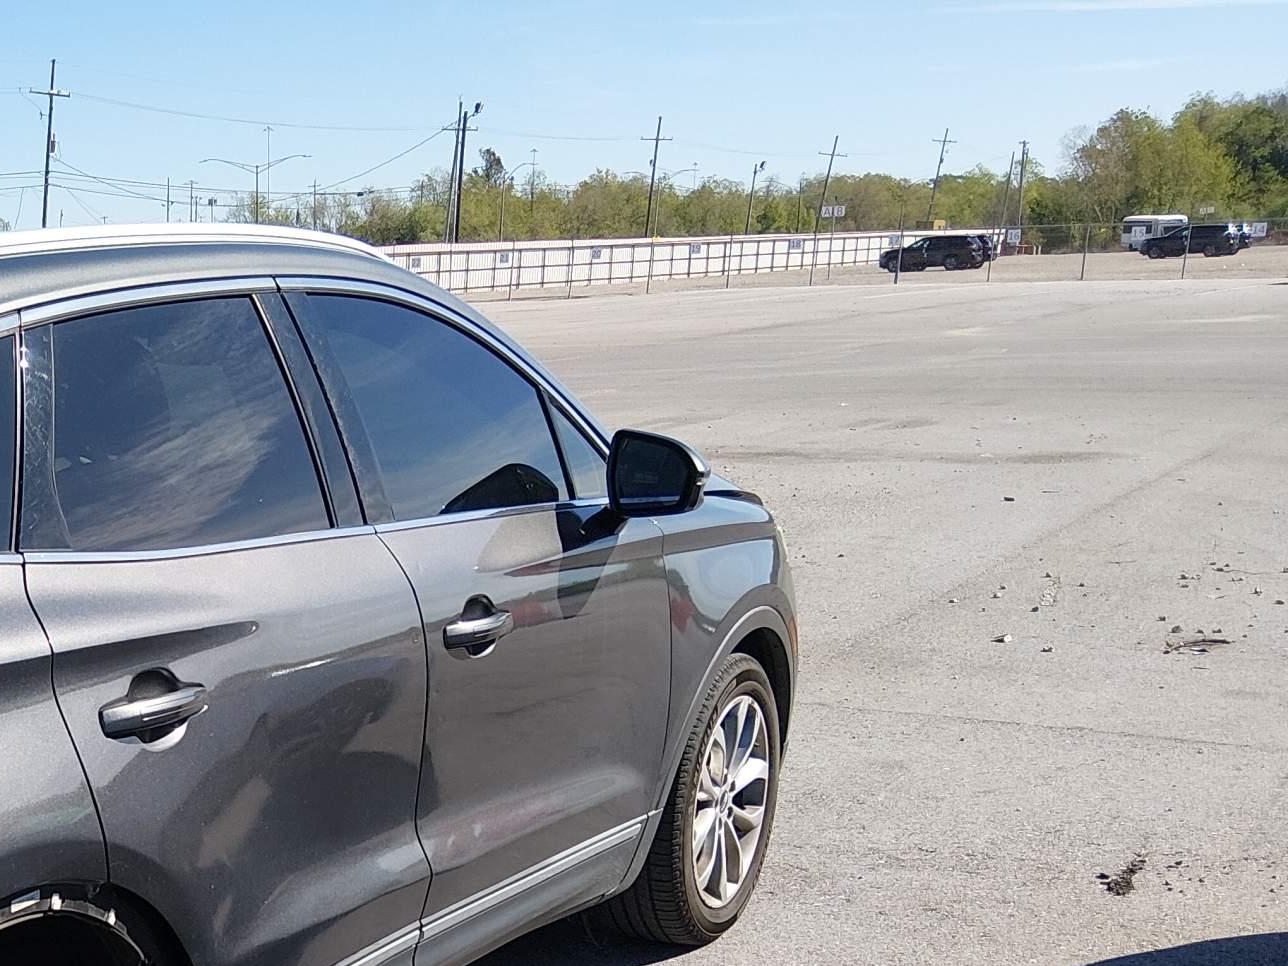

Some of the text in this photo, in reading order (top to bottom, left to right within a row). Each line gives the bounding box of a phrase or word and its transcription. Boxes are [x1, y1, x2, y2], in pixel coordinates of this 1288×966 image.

[1009, 231, 1019, 240] 16
[1133, 229, 1144, 238] 15
[792, 239, 802, 248] 18
[692, 244, 701, 253] 19
[591, 250, 601, 258] 20
